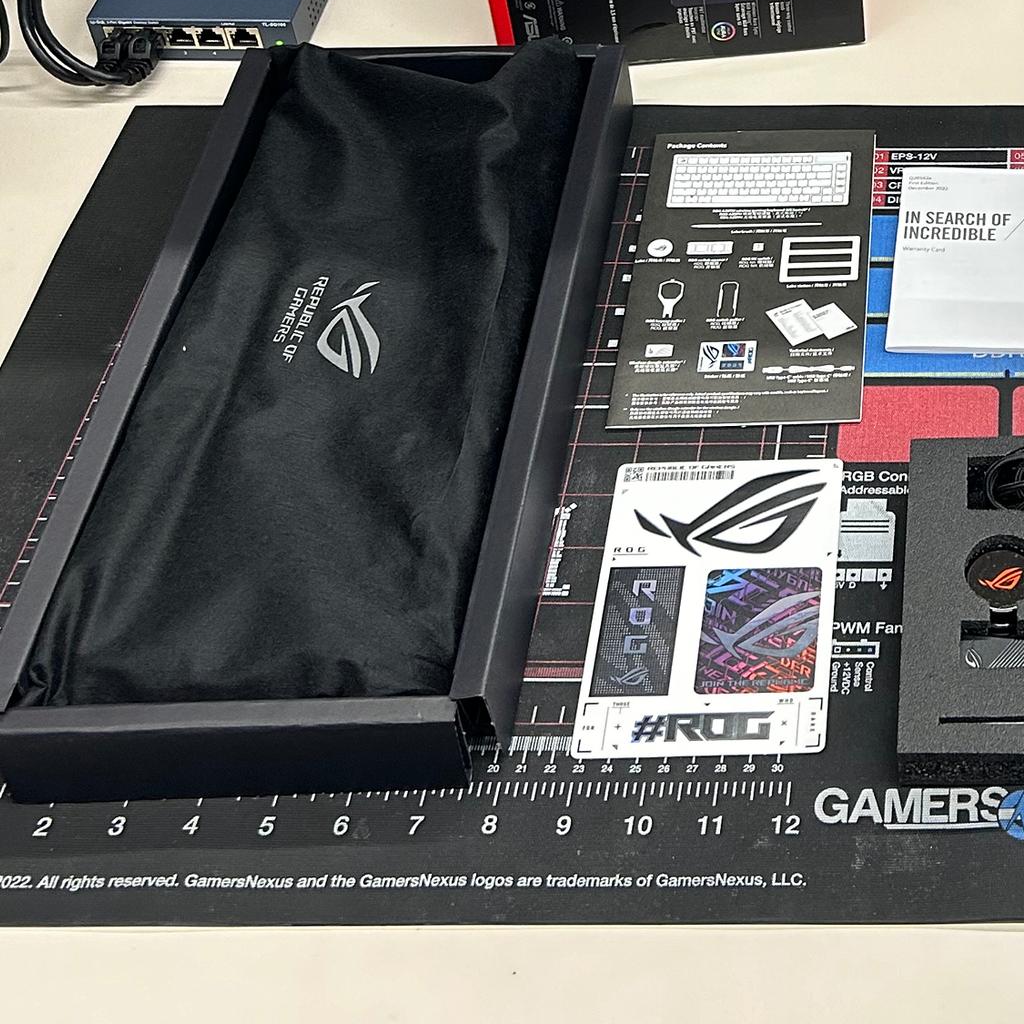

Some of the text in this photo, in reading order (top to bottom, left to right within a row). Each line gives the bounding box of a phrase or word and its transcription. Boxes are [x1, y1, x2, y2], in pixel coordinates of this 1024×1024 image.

[891, 152, 938, 161] EPS-12V
[905, 211, 1011, 227] IN SEARCH OF
[903, 226, 997, 241] INCREDIBLE
[273, 287, 308, 343] GAMERS
[282, 276, 330, 363] REPUBLIC OF
[875, 621, 903, 634] Fan
[830, 661, 841, 693] Ground
[841, 661, 852, 695] +12VDC
[853, 661, 864, 688] Sense
[864, 661, 875, 692] Control
[631, 711, 775, 743] #ROG
[488, 764, 784, 773] 20 21 22 23 24 25 26 27 28 29 30
[814, 786, 1008, 827] GAMERS
[32, 815, 801, 836] 2 3 4 5 6 7 8 9 10 11 12
[36, 875, 60, 889] All
[60, 875, 105, 891] rights
[108, 874, 179, 888] reserved.
[184, 874, 293, 889] GamersNexus
[297, 874, 327, 888] and
[330, 874, 355, 888] the
[359, 874, 467, 888] GamersNexus
[471, 874, 514, 890] logos
[517, 876, 542, 887] are
[546, 874, 633, 888] trademarks
[636, 873, 654, 887] of
[656, 873, 767, 889] GamersNexus,
[771, 872, 807, 887] LLC.
